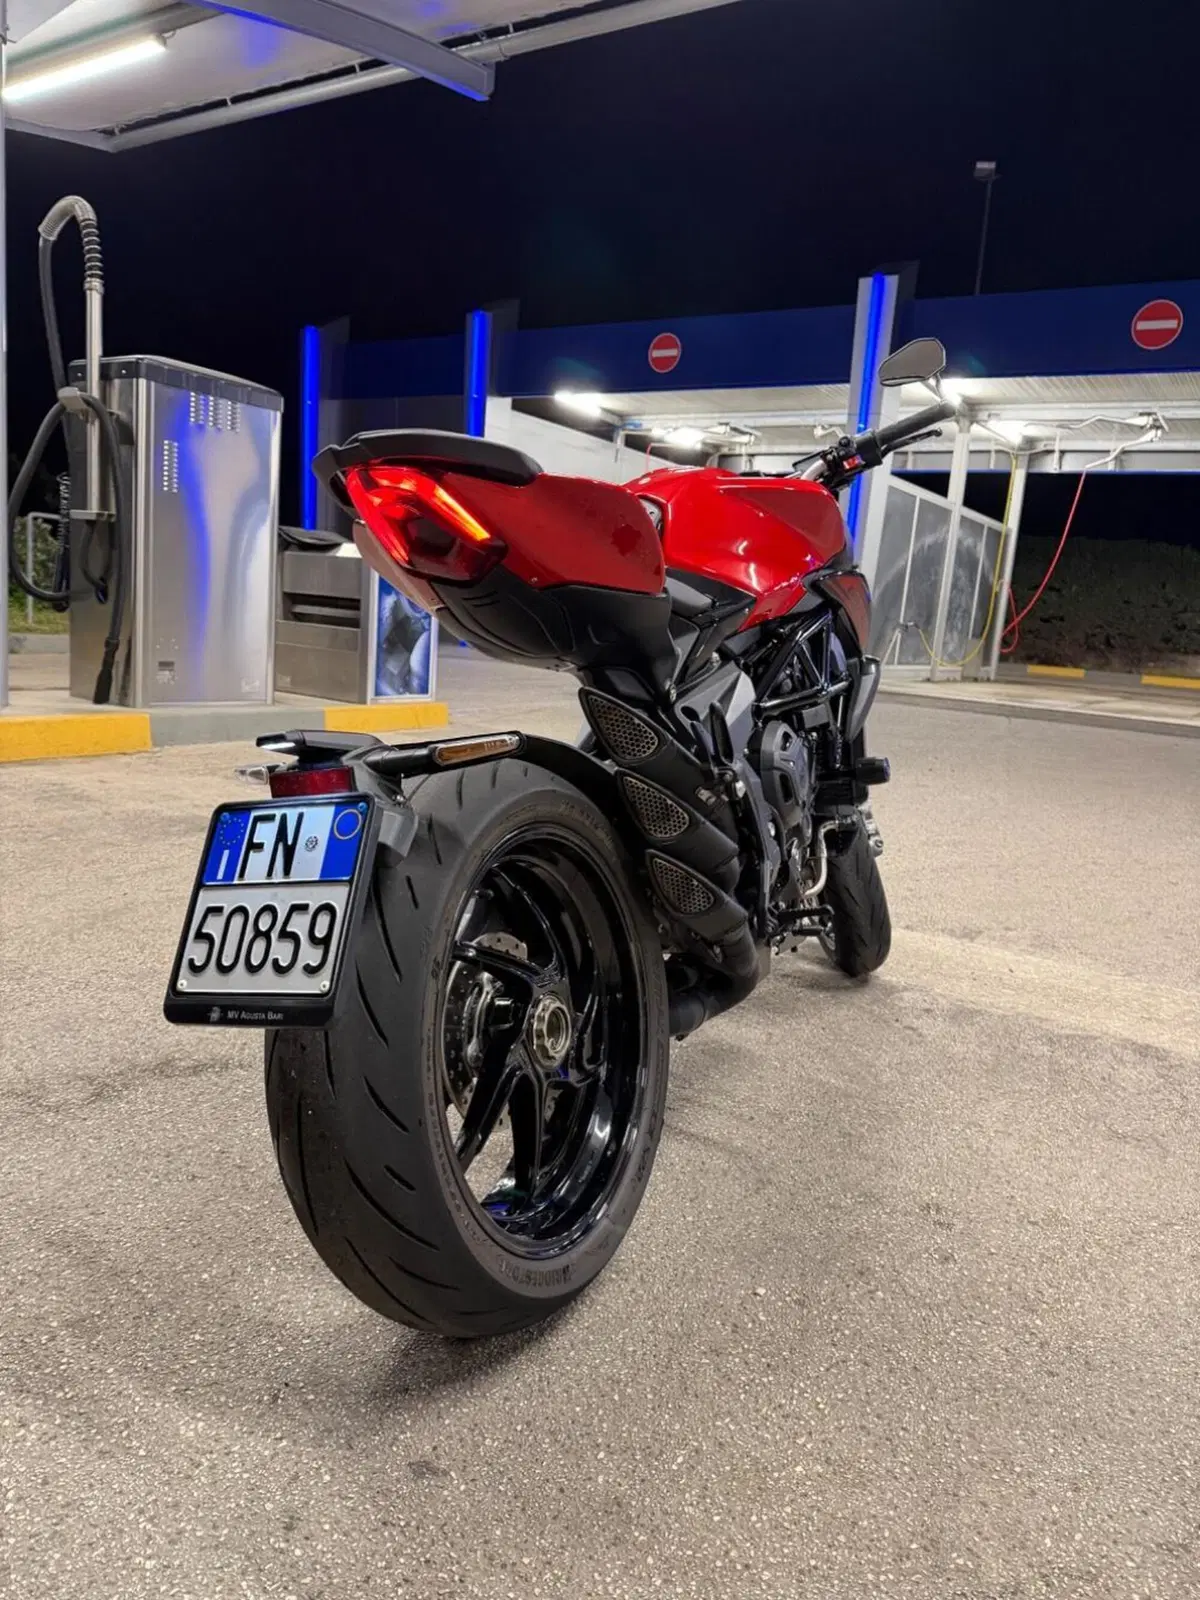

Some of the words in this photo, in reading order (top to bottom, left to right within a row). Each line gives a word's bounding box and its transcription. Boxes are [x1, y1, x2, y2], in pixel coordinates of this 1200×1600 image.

[238, 811, 304, 879] FN
[187, 902, 338, 975] 50859
[227, 1010, 240, 1019] MV
